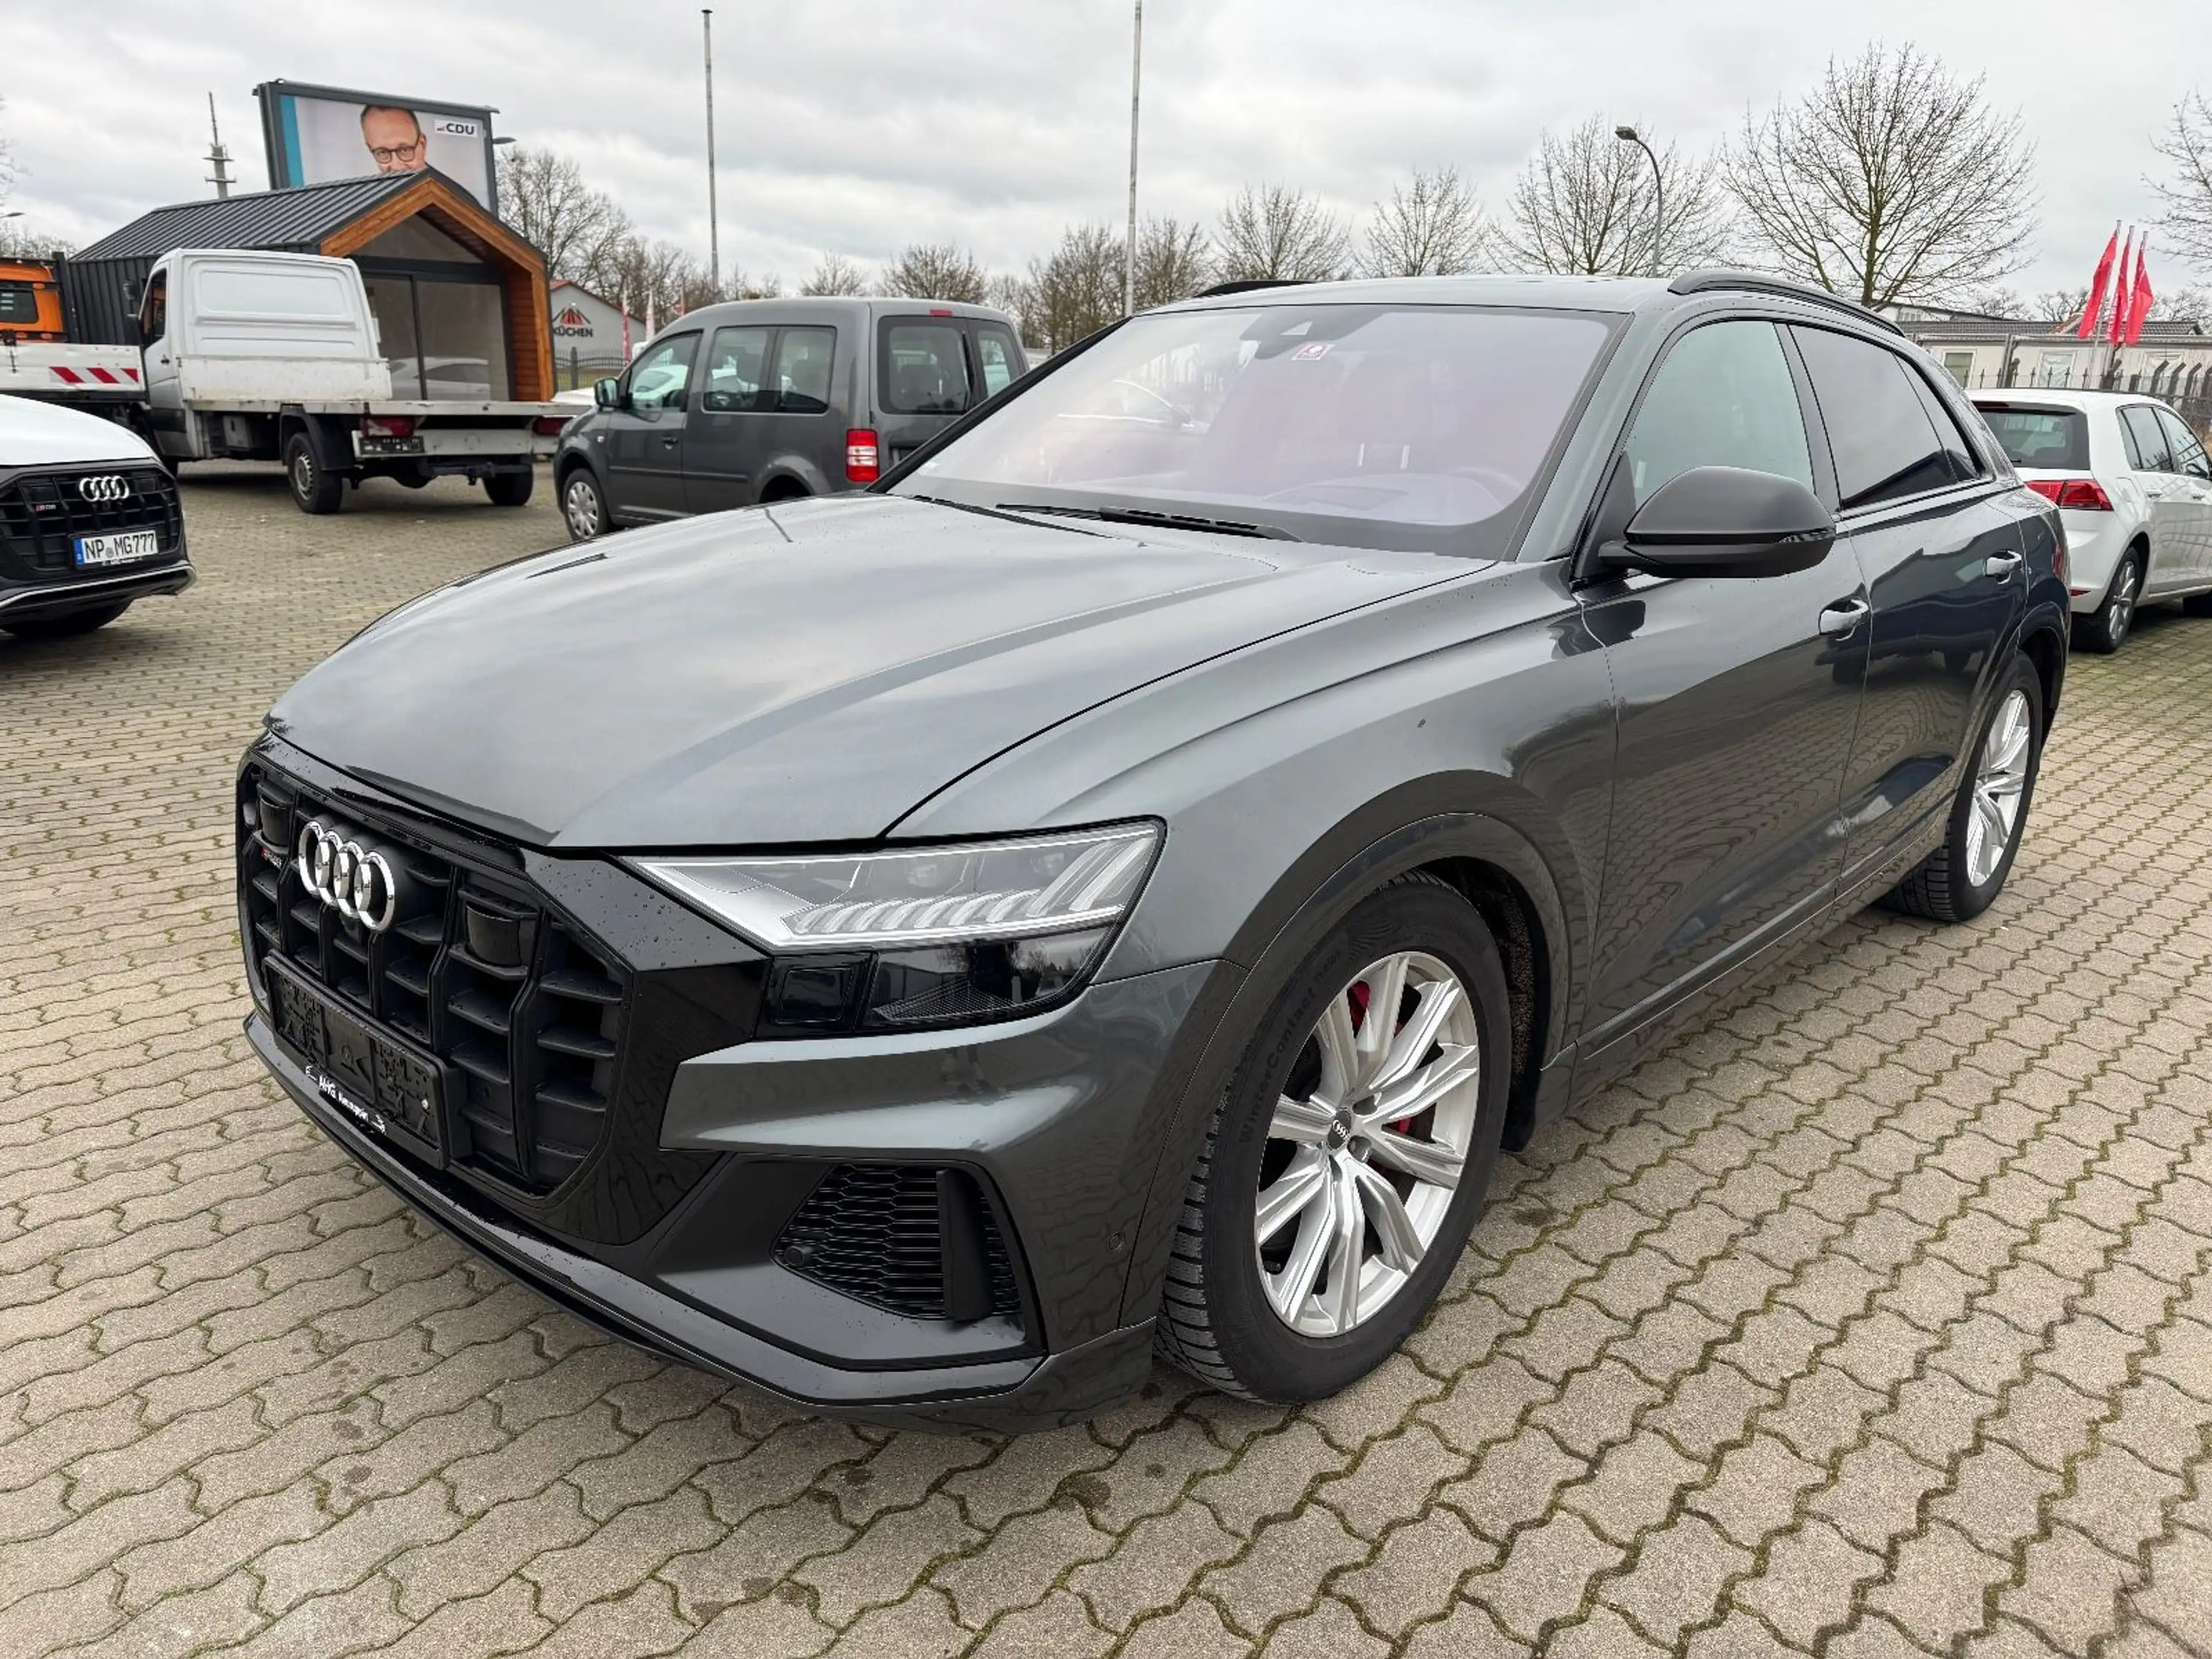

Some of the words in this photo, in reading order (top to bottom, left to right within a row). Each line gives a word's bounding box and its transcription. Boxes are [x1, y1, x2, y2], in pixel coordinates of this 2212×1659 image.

[446, 123, 475, 135] CDU
[85, 539, 104, 559] NP
[113, 533, 154, 555] MG777
[1239, 986, 1317, 1143] WinterContact
